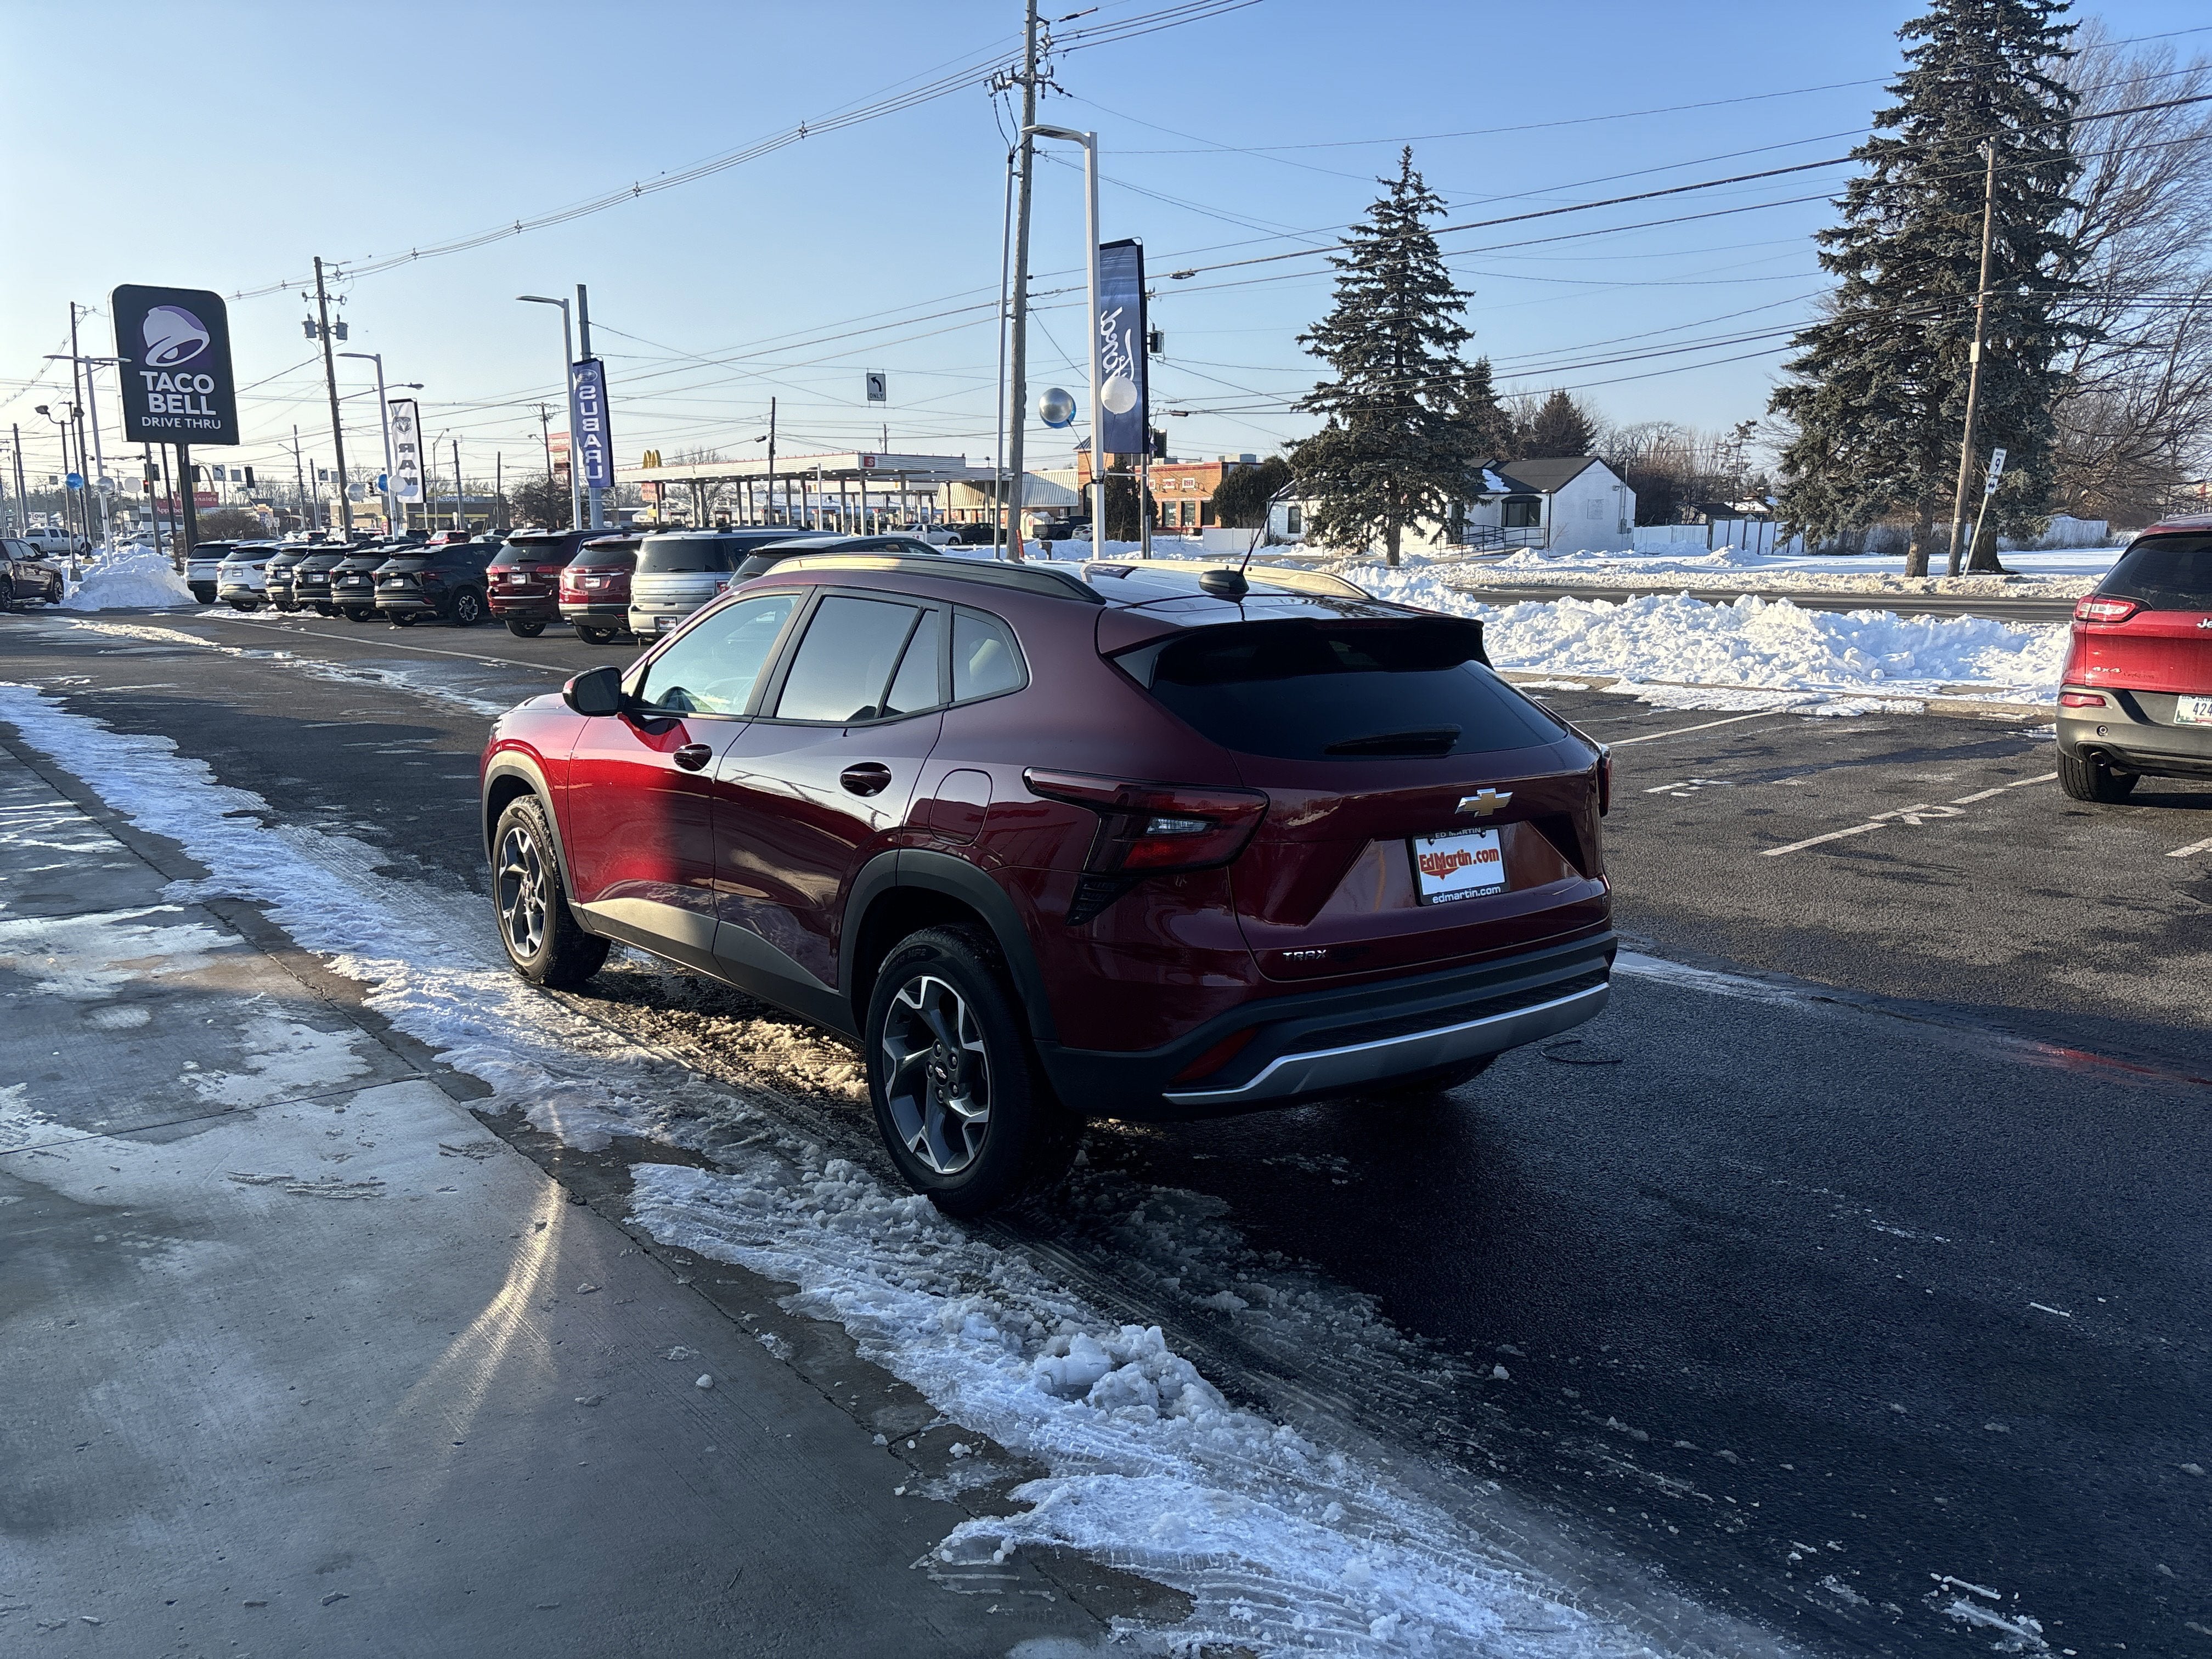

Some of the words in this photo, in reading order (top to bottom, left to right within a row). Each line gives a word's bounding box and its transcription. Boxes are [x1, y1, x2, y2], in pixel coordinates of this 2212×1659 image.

[139, 371, 215, 394] TACO
[148, 393, 216, 415] BELL
[142, 416, 182, 428] DRIVE
[184, 419, 221, 430] THRU
[1994, 458, 2001, 473] 9
[1449, 827, 1481, 837] MARTIN
[1419, 848, 1499, 873] EdMartin.com
[1432, 886, 1501, 904] edmartin.com
[1283, 950, 1327, 961] TRAX
